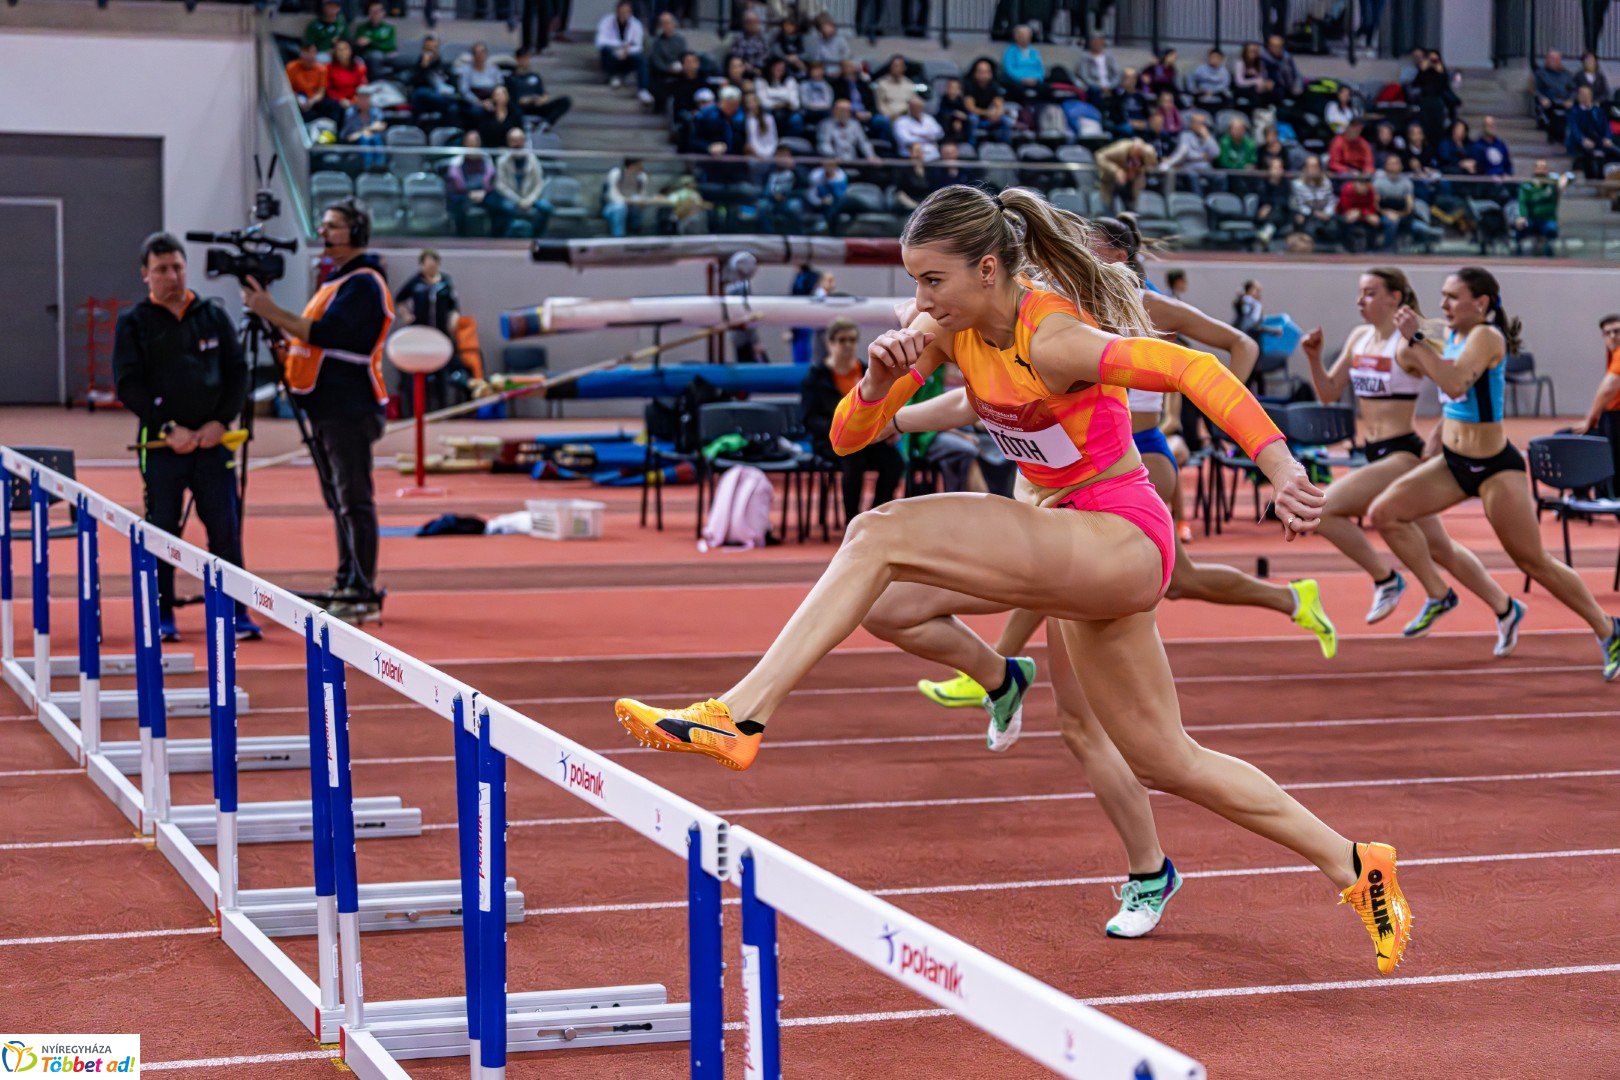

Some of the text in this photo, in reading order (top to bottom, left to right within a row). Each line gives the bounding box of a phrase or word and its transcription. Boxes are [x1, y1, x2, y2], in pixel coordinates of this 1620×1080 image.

[989, 429, 1048, 463] TÓTH
[381, 658, 404, 684] polanik
[570, 763, 604, 798] polanik
[1368, 869, 1394, 941] NITRO
[901, 944, 964, 998] polanik
